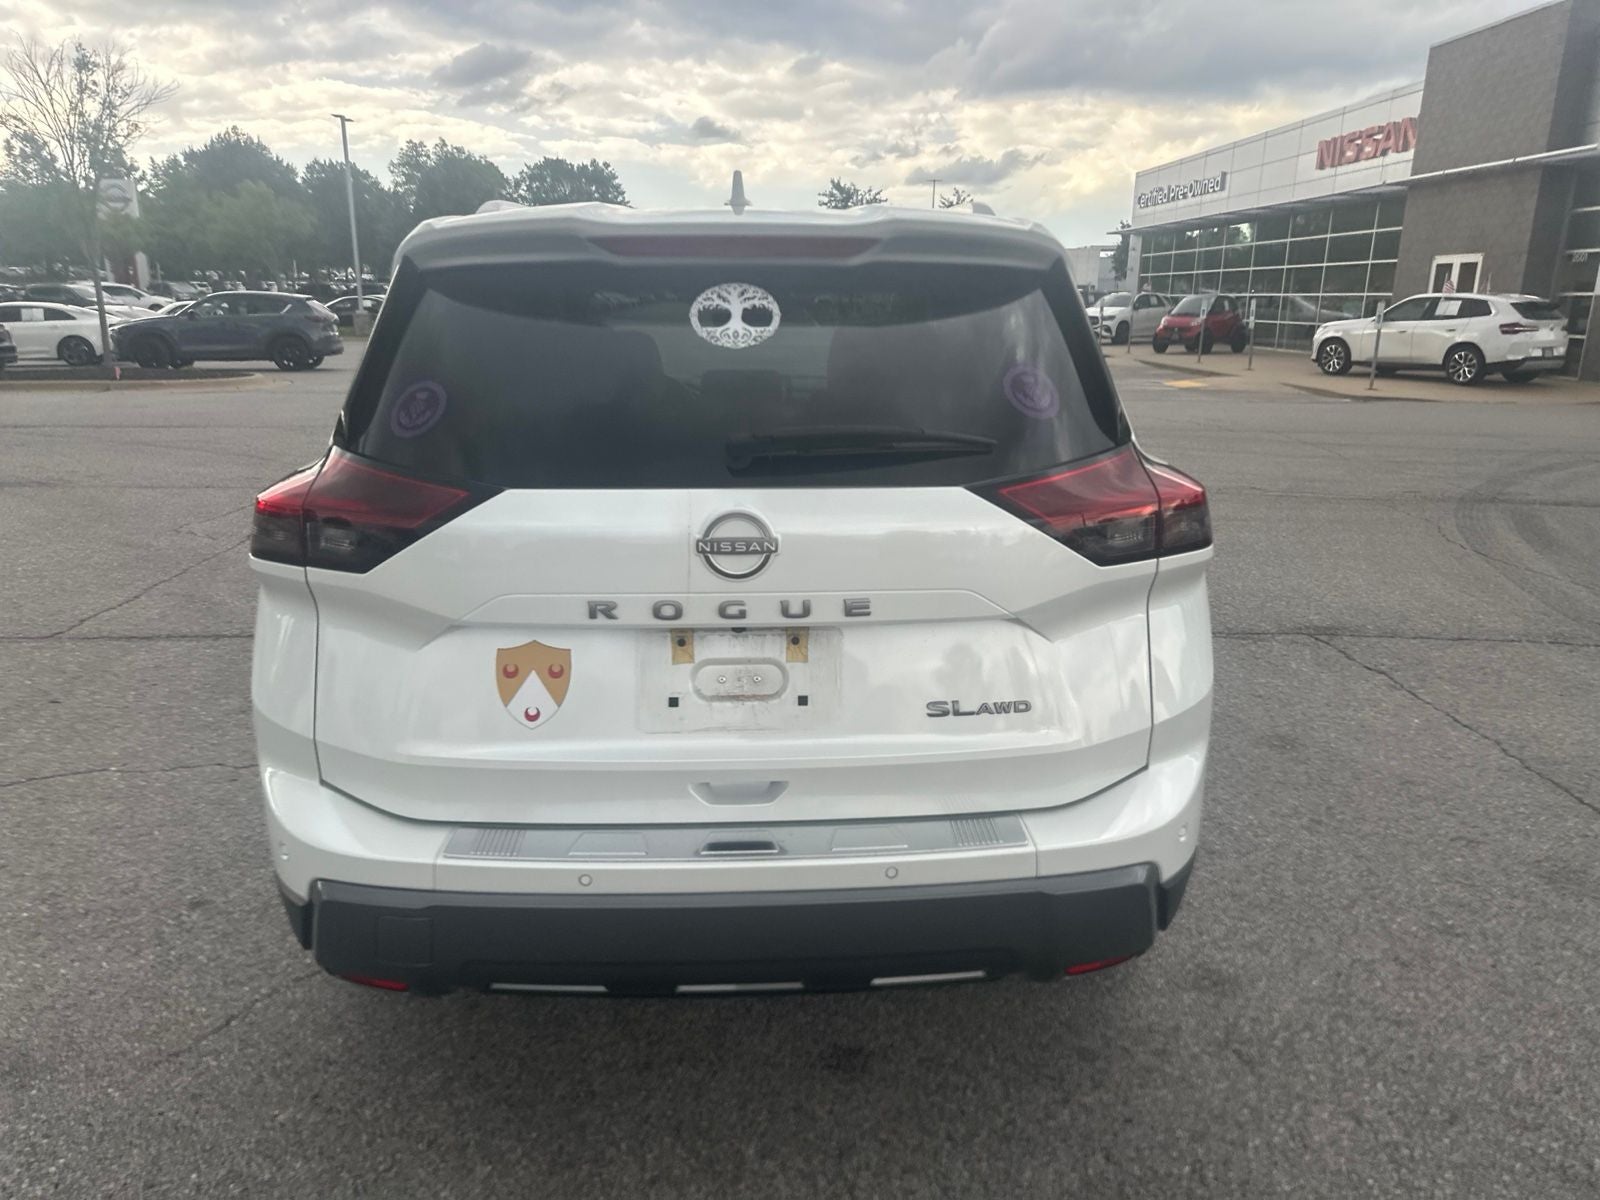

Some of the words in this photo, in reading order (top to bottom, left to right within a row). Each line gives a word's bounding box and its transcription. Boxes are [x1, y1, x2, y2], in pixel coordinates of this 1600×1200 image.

[1315, 117, 1417, 170] NISSAN
[698, 541, 776, 552] NISSAN
[587, 598, 872, 620] ROGUE
